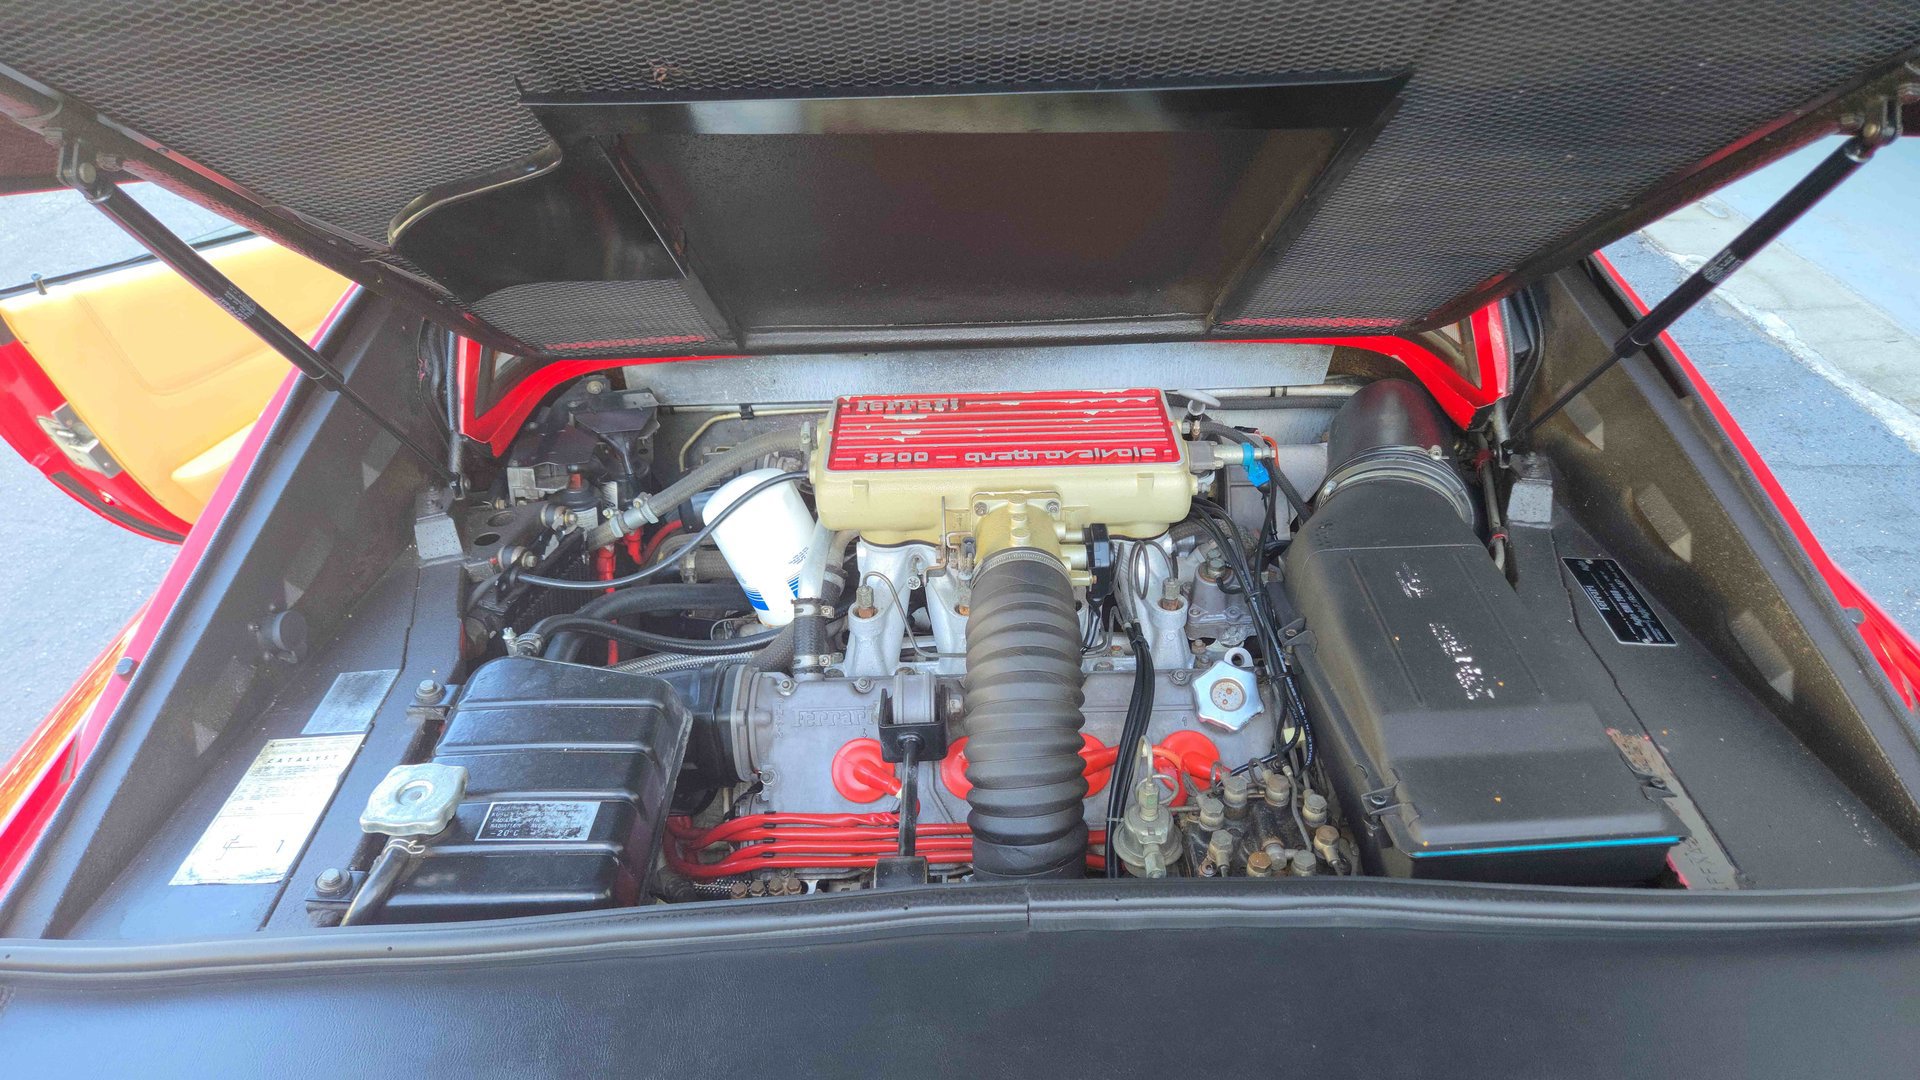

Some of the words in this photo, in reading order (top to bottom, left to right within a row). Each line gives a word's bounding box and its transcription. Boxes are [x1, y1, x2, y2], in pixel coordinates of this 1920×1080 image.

[856, 397, 959, 412] Ferrari
[863, 451, 929, 464] 3200
[964, 447, 1157, 464] quattrovalvole
